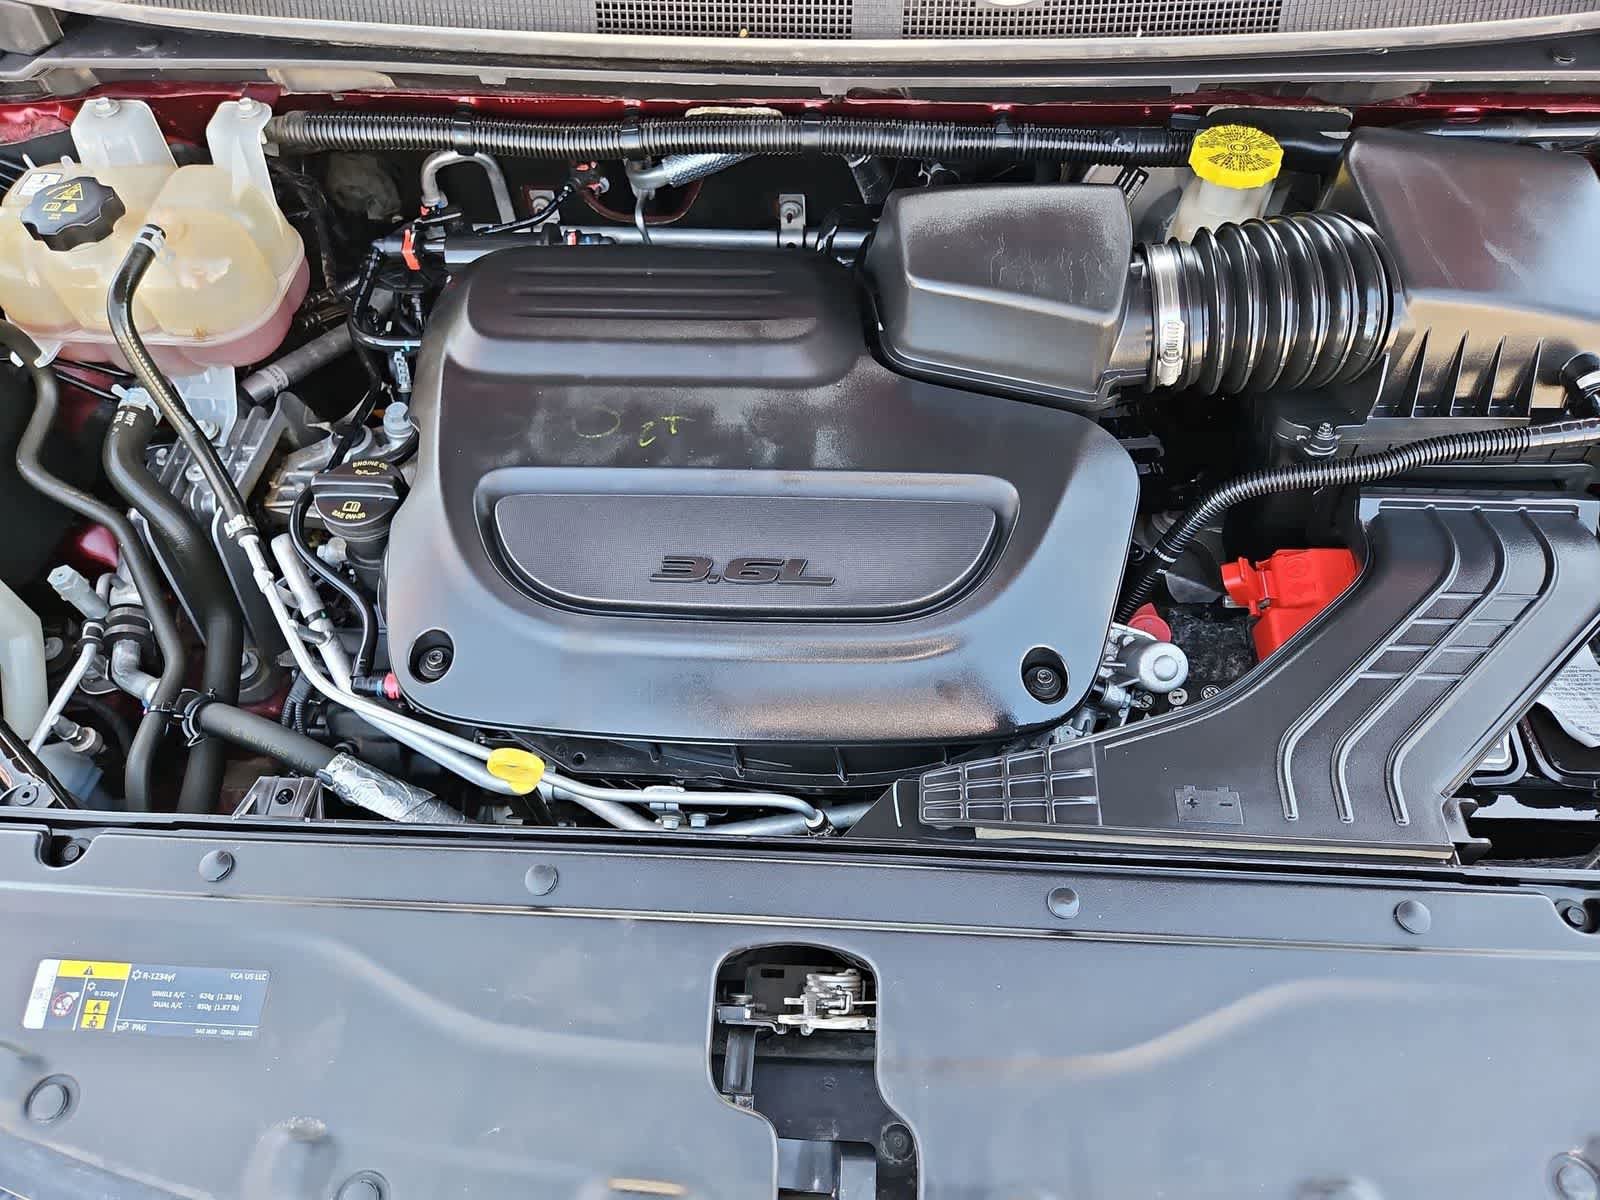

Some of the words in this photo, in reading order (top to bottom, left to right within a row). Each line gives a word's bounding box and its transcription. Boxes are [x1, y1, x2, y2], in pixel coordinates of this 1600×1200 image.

[352, 460, 379, 468] ENGINE
[650, 555, 835, 587] 3.6L
[142, 972, 176, 983] R-1234yf
[244, 973, 254, 981] US
[254, 973, 268, 981] LLC
[153, 1001, 170, 1009] DUAL
[131, 1024, 147, 1032] PAG
